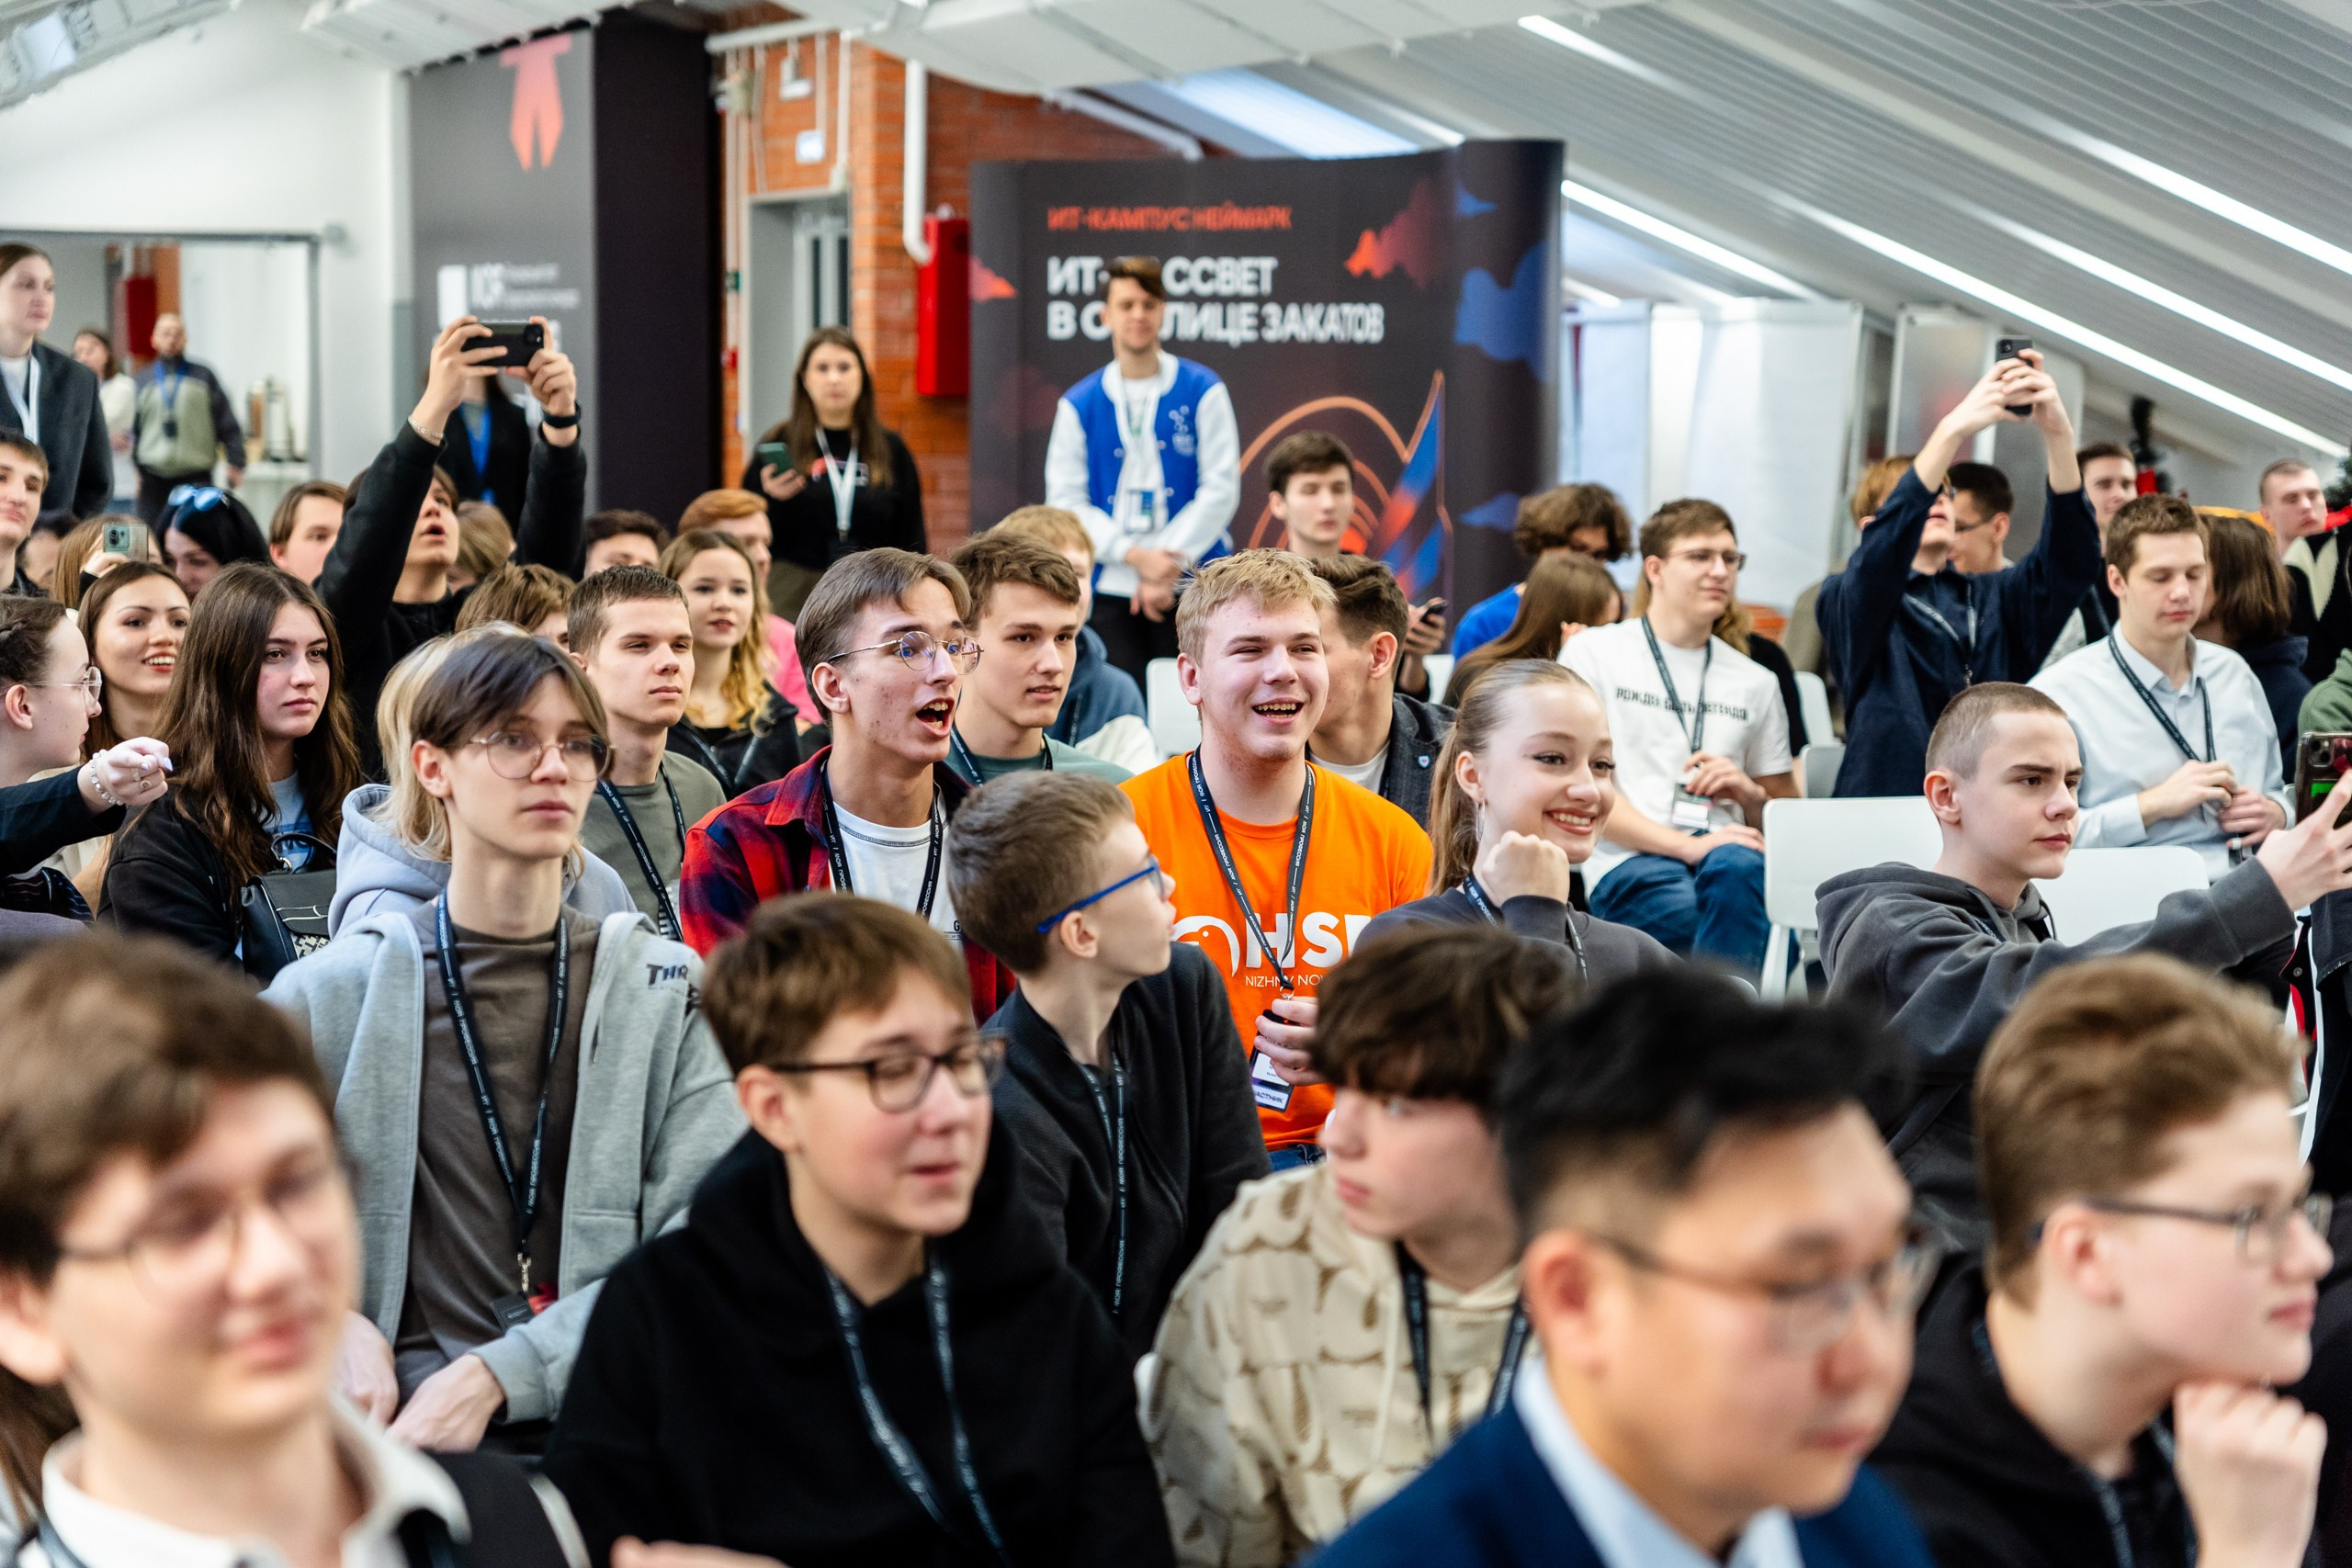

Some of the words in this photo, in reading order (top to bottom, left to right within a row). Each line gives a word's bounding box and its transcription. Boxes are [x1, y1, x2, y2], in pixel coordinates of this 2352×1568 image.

[1046, 300, 1077, 341] В
[1080, 300, 1260, 348] СЛИЦЕ
[1261, 302, 1385, 343] ЗАКАТОВ
